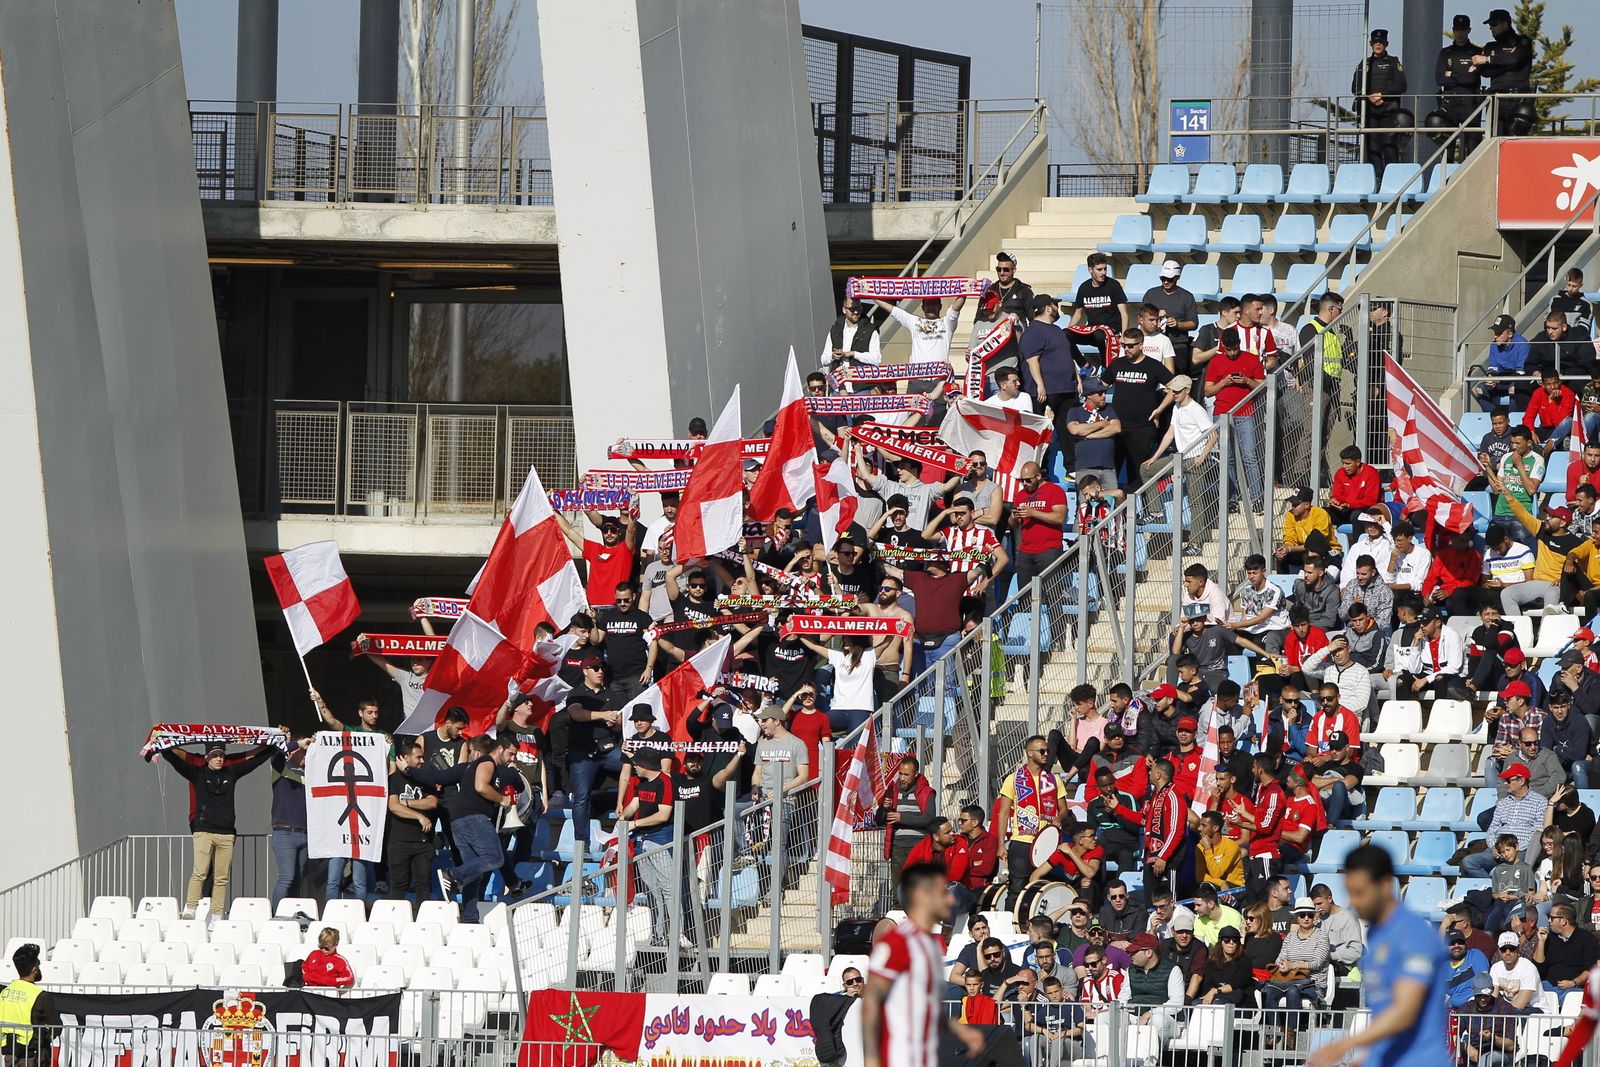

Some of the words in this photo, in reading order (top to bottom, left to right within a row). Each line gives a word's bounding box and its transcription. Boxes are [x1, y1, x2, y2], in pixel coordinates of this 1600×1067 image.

[1179, 114, 1208, 131] 141
[319, 734, 376, 747] ALMERIA
[686, 740, 740, 753] LEALTAD
[341, 833, 371, 845] FANS
